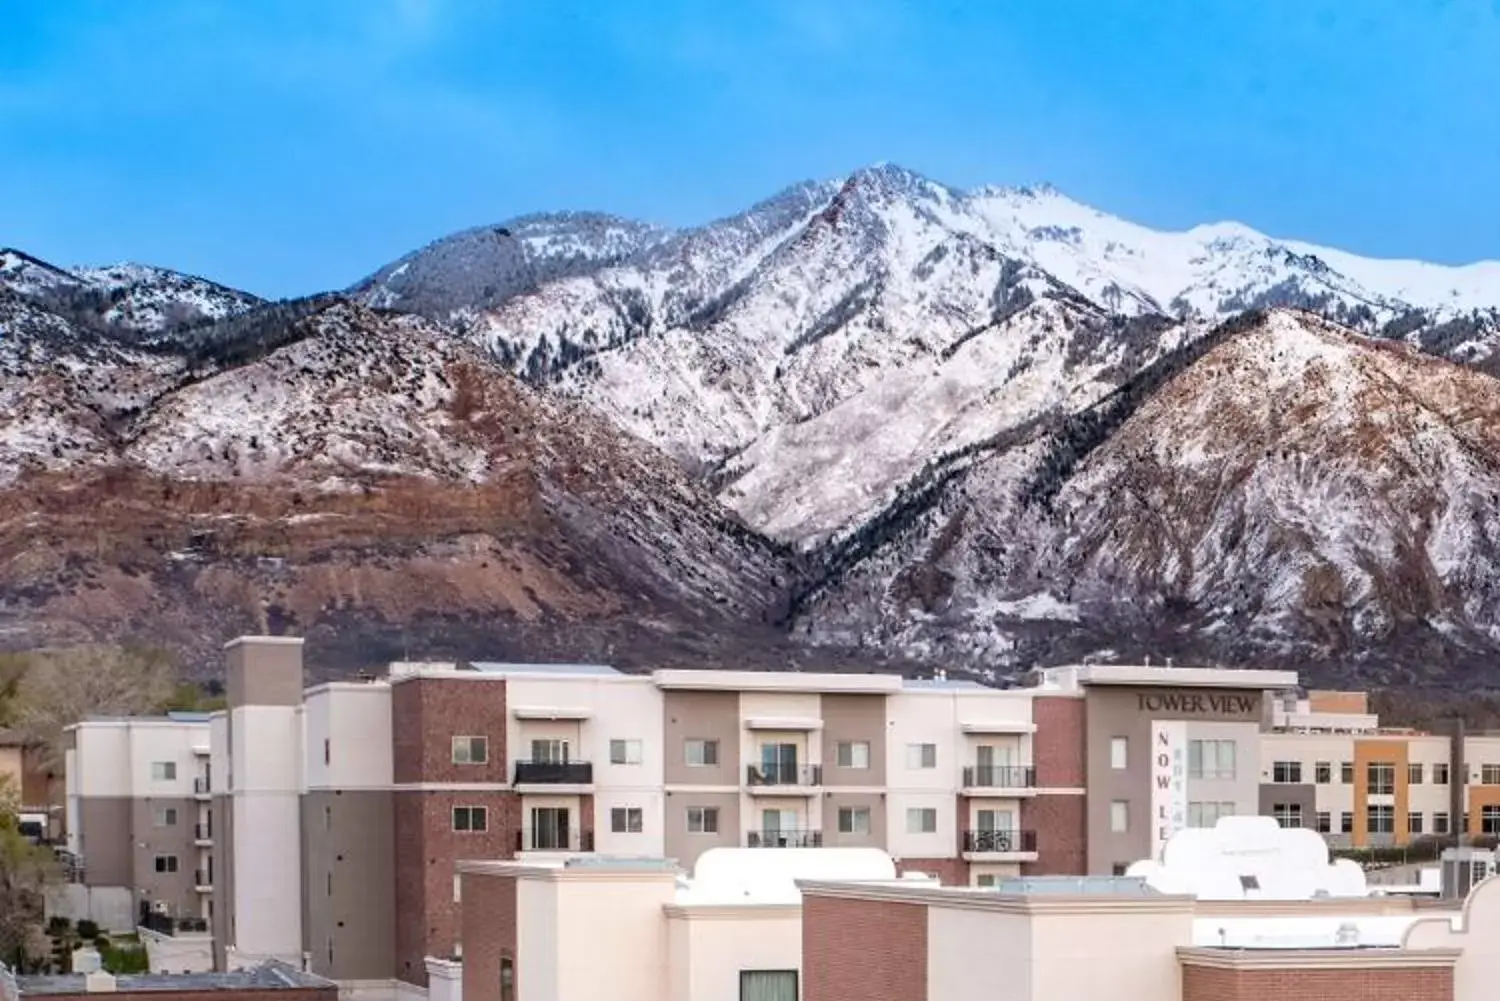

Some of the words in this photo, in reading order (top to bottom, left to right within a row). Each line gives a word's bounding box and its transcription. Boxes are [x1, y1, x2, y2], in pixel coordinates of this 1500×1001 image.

[1137, 693, 1206, 713] TOWER
[1208, 695, 1257, 714] VIEW
[1157, 731, 1171, 789] NOW
